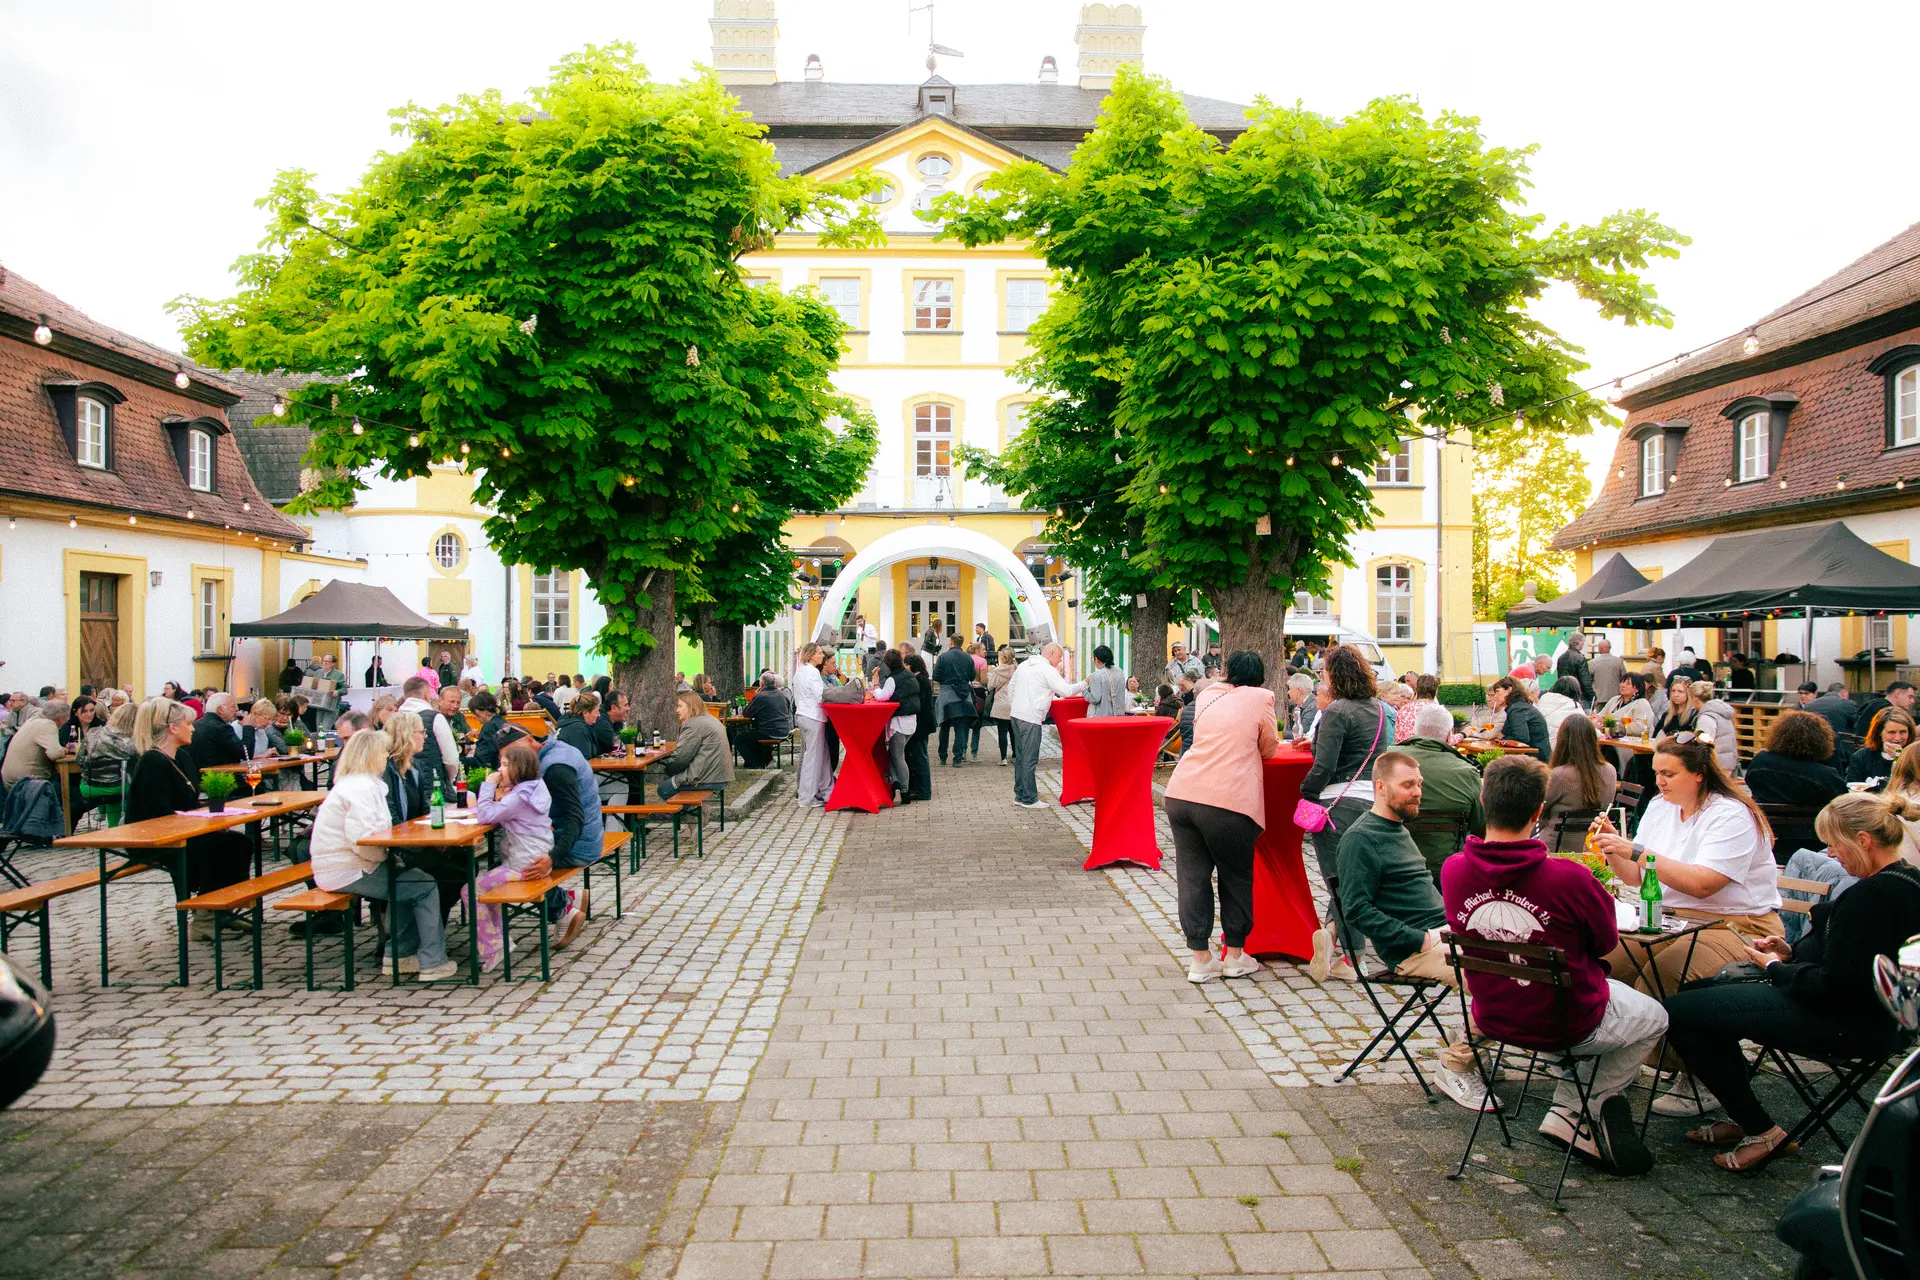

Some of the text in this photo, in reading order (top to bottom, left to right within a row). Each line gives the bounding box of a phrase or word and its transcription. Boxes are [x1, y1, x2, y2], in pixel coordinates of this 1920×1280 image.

[1464, 889, 1495, 911] Michael
[1503, 889, 1538, 913] Protect
[1455, 1079, 1466, 1093] FILA
